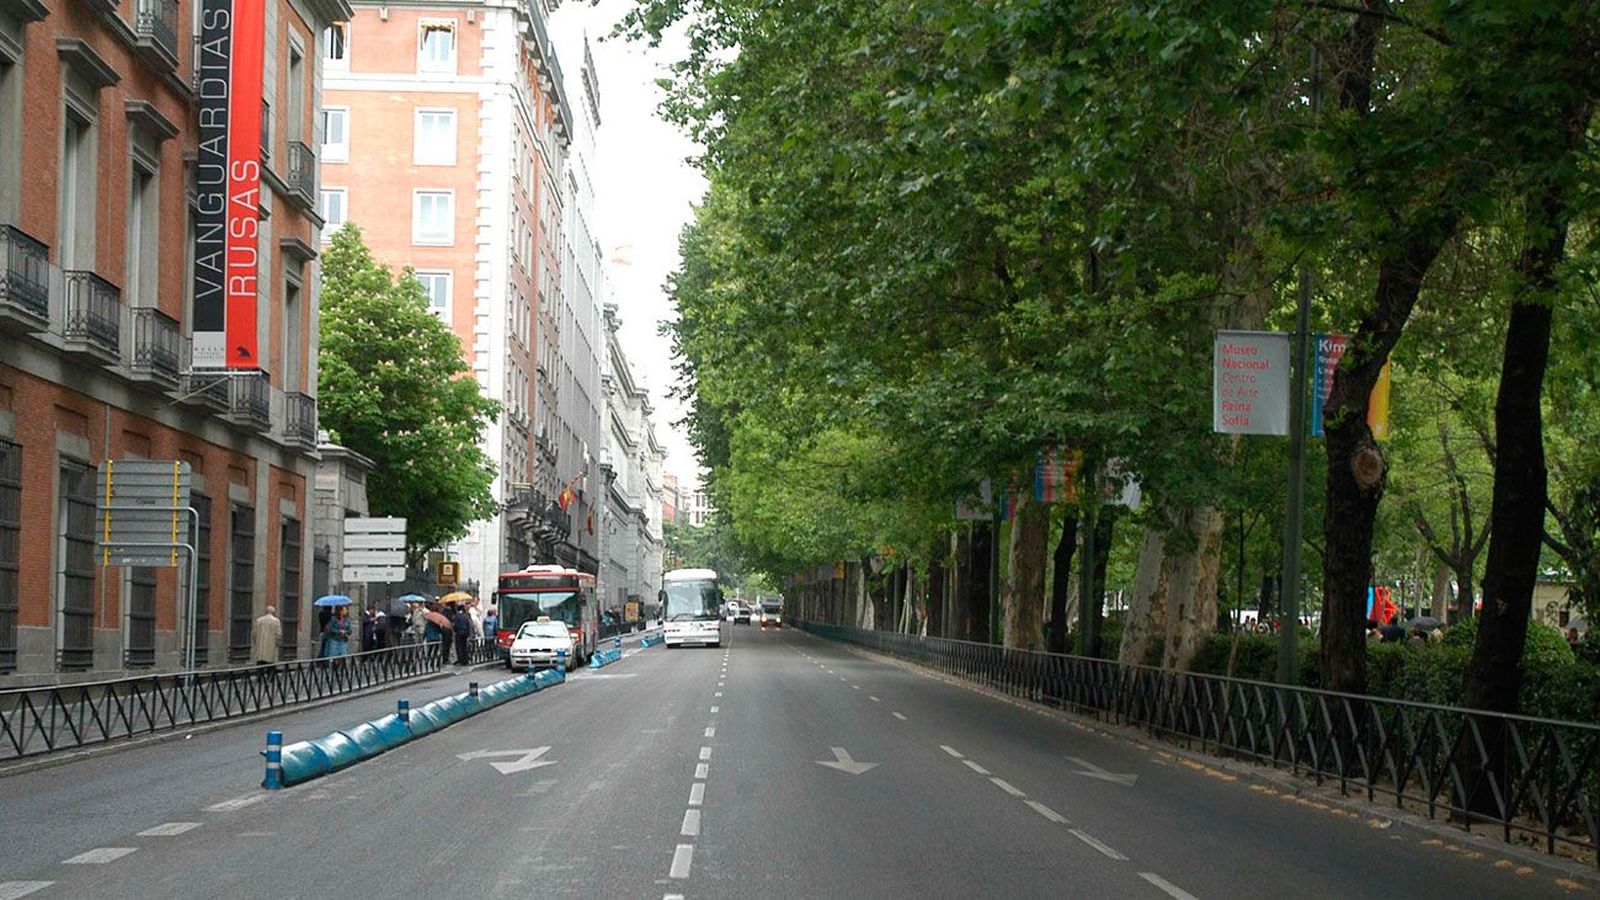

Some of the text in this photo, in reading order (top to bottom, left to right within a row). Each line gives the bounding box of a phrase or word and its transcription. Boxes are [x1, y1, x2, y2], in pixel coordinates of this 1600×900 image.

[195, 9, 230, 298] VANGUARDIAS
[229, 160, 260, 296] RUSAS
[1222, 344, 1257, 355] Museo
[1222, 358, 1269, 370] Nacional
[1222, 372, 1256, 383] Centro
[1222, 386, 1259, 398] de Arte
[1222, 401, 1251, 411] Reina
